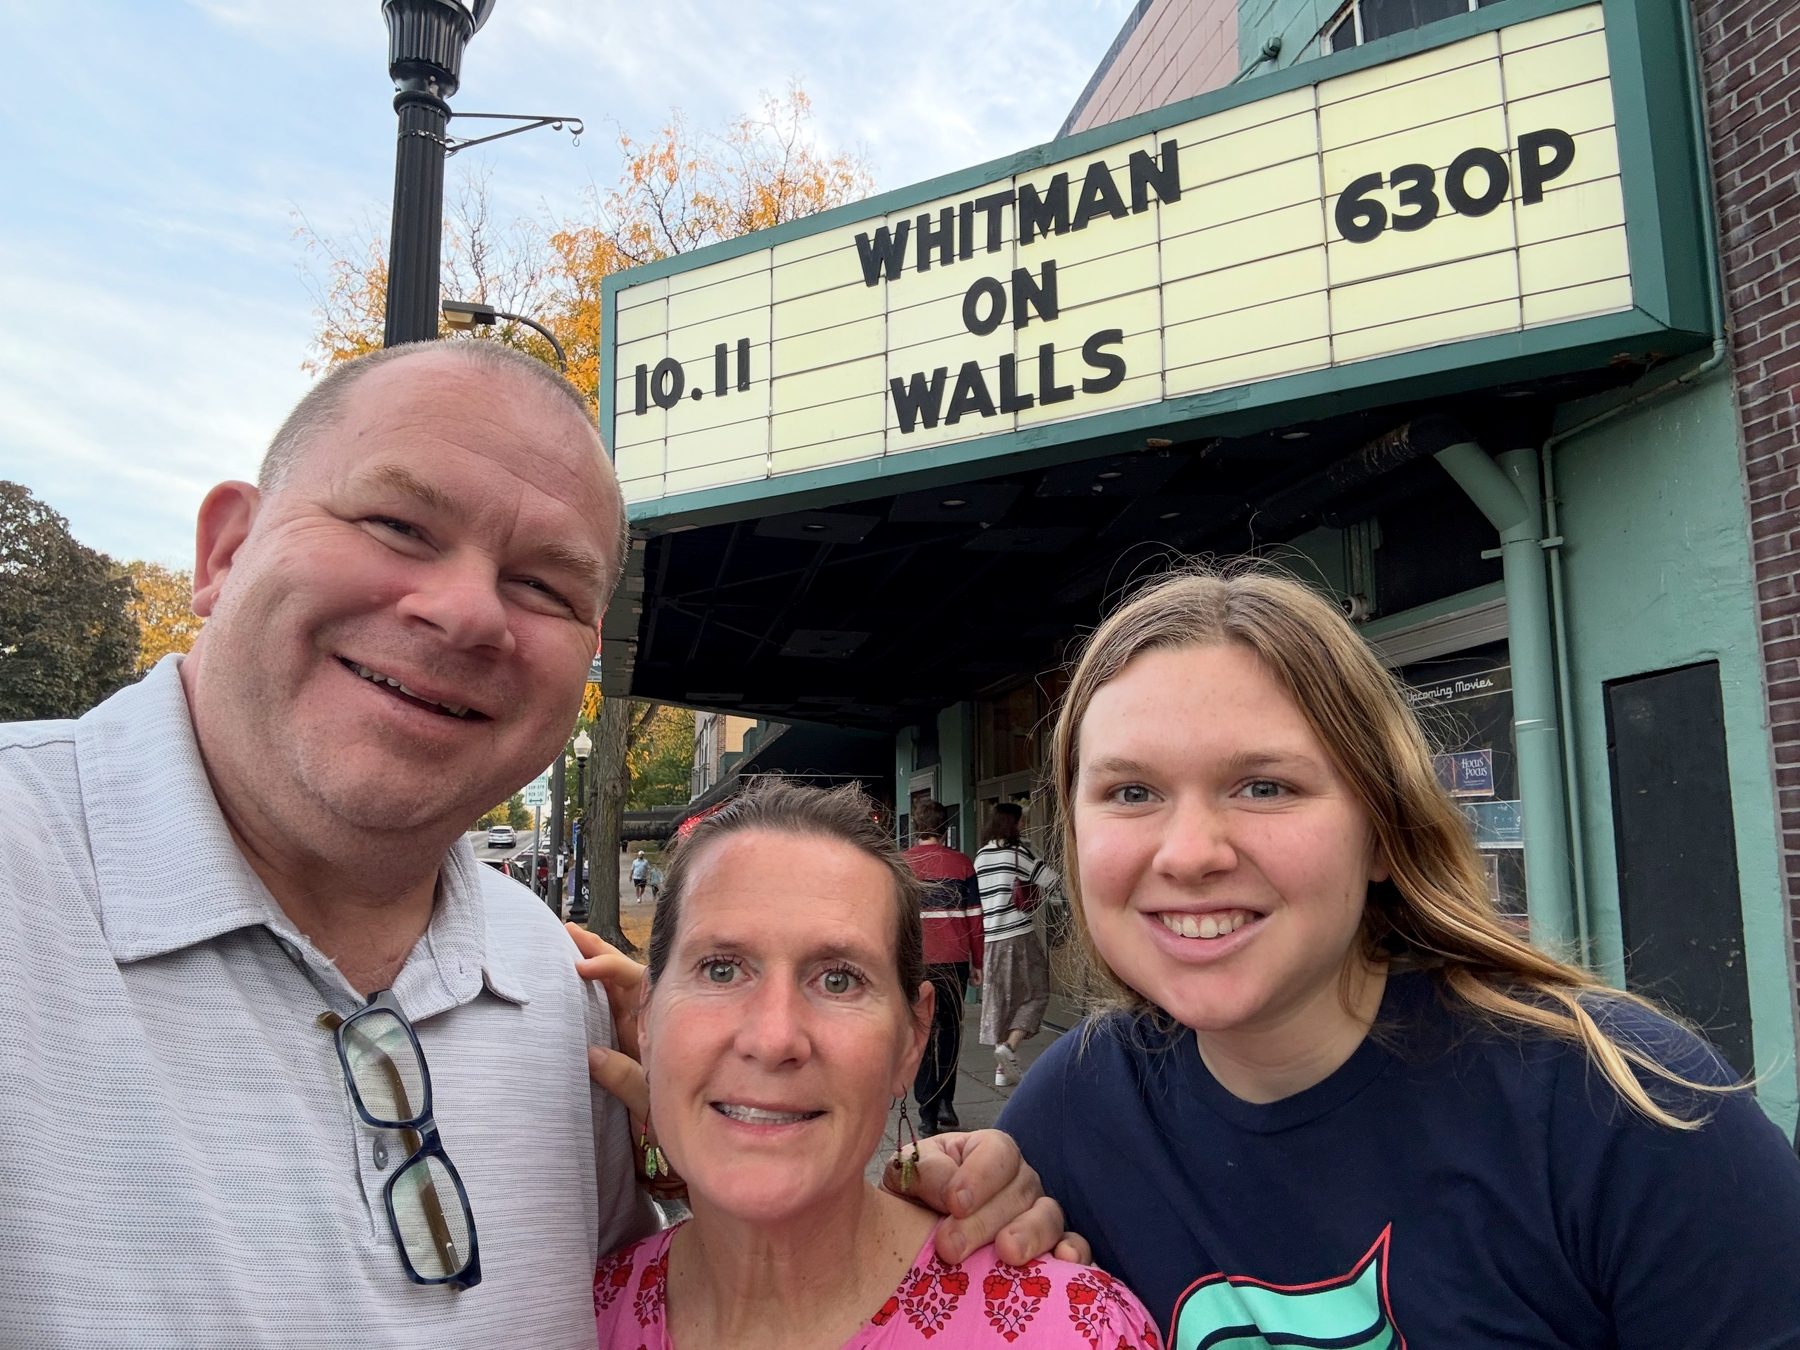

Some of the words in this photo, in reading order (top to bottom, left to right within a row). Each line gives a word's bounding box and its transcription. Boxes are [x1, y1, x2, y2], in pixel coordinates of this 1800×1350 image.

[855, 139, 1182, 287] WHITMAN
[1335, 128, 1575, 244] 630P
[962, 259, 1059, 336] ON
[634, 337, 751, 416] 10.11
[890, 328, 1127, 434] WALLS
[1407, 686, 1453, 704] Upcoming
[1455, 678, 1494, 693] Movies
